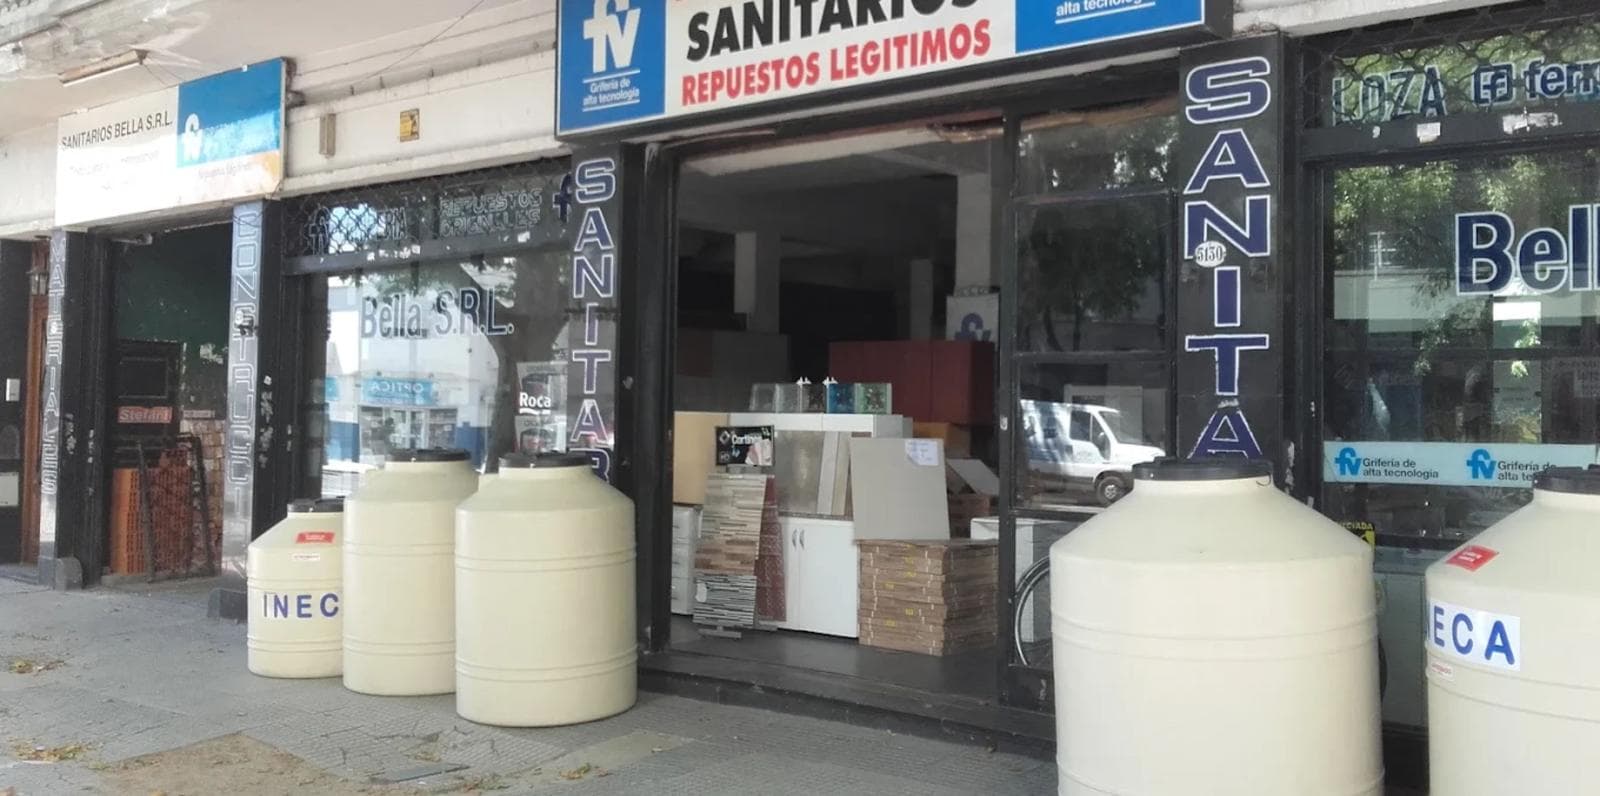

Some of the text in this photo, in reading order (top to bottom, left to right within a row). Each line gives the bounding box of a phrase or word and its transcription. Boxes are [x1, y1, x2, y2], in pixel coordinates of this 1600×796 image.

[687, 0, 981, 61] SANITAR
[682, 19, 991, 106] REPUESTOS LEGITIMOS
[620, 77, 631, 88] de
[1333, 65, 1448, 126] LOZA
[62, 111, 174, 151] SANITARIOS BELLA S.R.L.
[1455, 203, 1600, 296] Bel
[435, 287, 515, 335] S.R.L.
[519, 392, 552, 408] Roca
[1334, 447, 1361, 476] fv
[1363, 467, 1382, 477] alta
[1403, 458, 1417, 468] de
[1466, 448, 1496, 479] fv
[1497, 471, 1519, 481] alta
